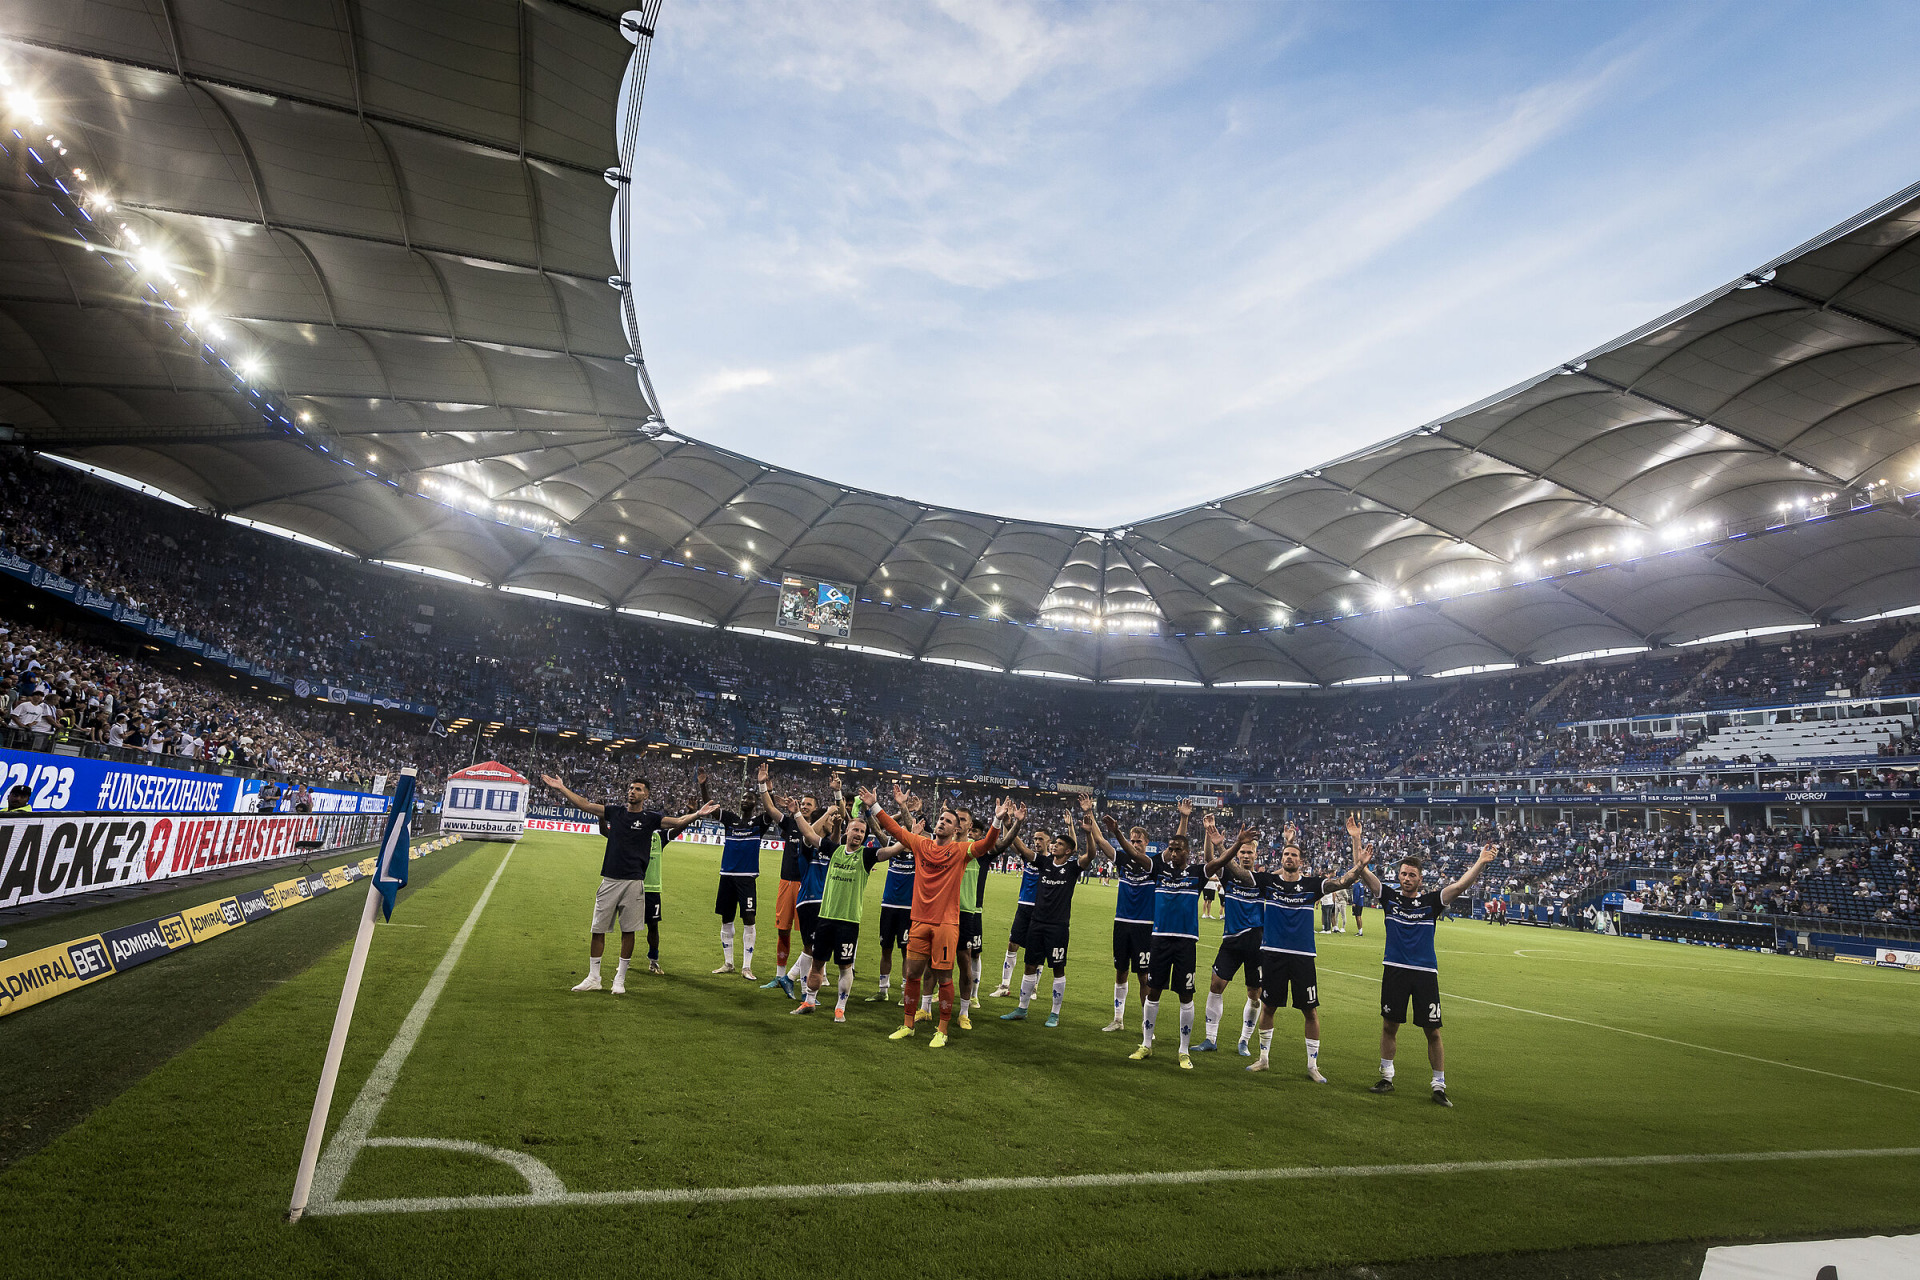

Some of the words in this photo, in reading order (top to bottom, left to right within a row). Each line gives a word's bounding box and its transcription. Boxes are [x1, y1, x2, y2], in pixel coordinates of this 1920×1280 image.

[759, 748, 776, 757] HSV
[777, 750, 828, 763] SUPPORTERS
[829, 757, 848, 766] CLUB
[97, 771, 223, 812] #UNSERZUHAUSE
[532, 805, 562, 817] DANIEL
[563, 807, 575, 818] ON
[443, 821, 517, 832] www.busbau.de
[524, 819, 591, 833] ENSTEYN
[746, 896, 753, 908] 5
[841, 943, 854, 957] 32
[943, 946, 948, 960] 1
[1052, 947, 1065, 960] 42
[1138, 951, 1151, 965] 29
[1306, 985, 1316, 1001] 11
[1428, 1002, 1441, 1018] 26
